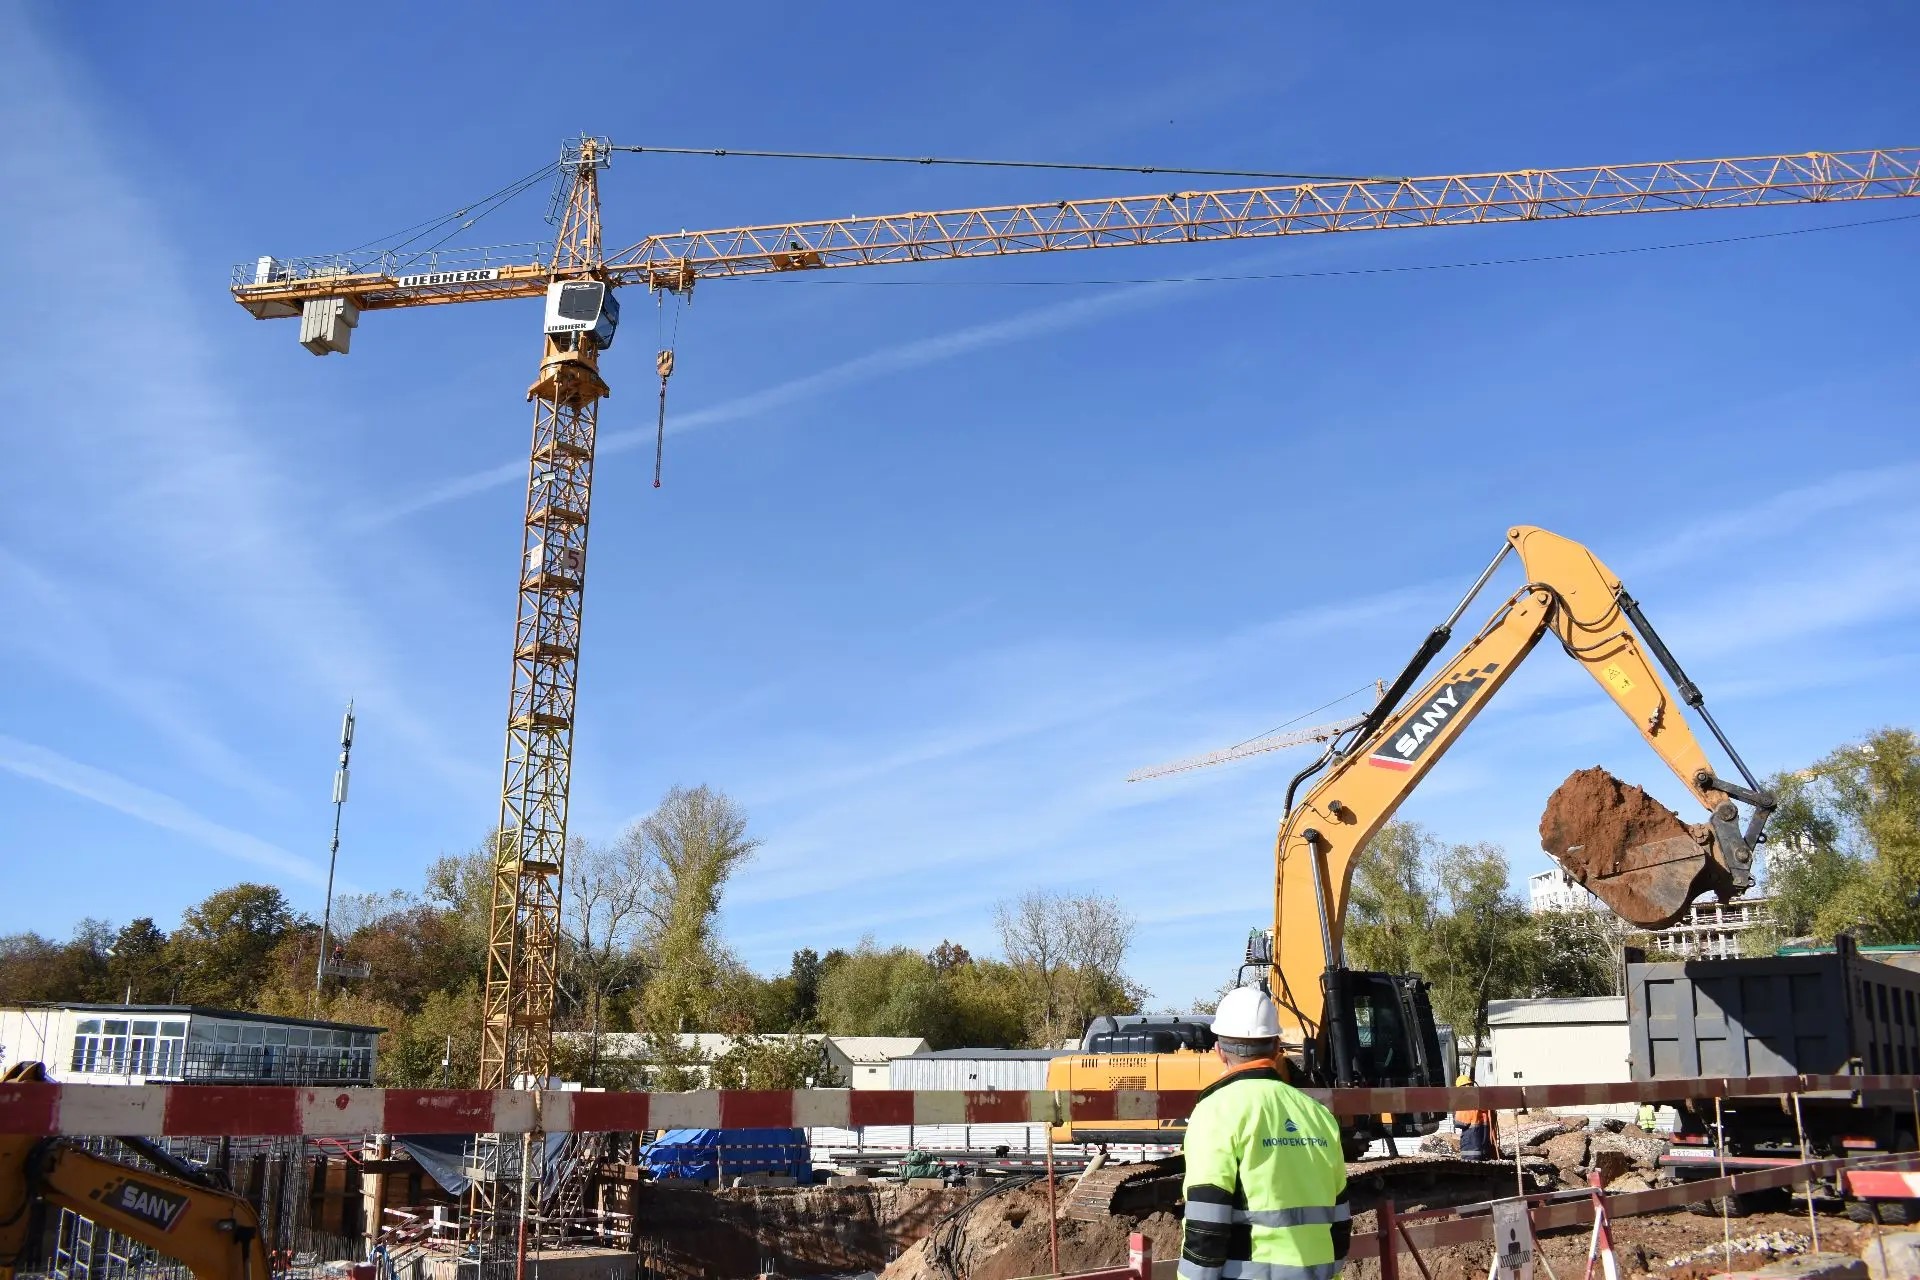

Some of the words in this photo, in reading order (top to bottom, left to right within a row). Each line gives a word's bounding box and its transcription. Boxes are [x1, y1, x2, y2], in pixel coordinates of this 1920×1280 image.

[403, 270, 491, 286] LIEBHERR
[568, 550, 580, 569] 5
[1395, 686, 1459, 758] SANY
[121, 1185, 177, 1222] SANY
